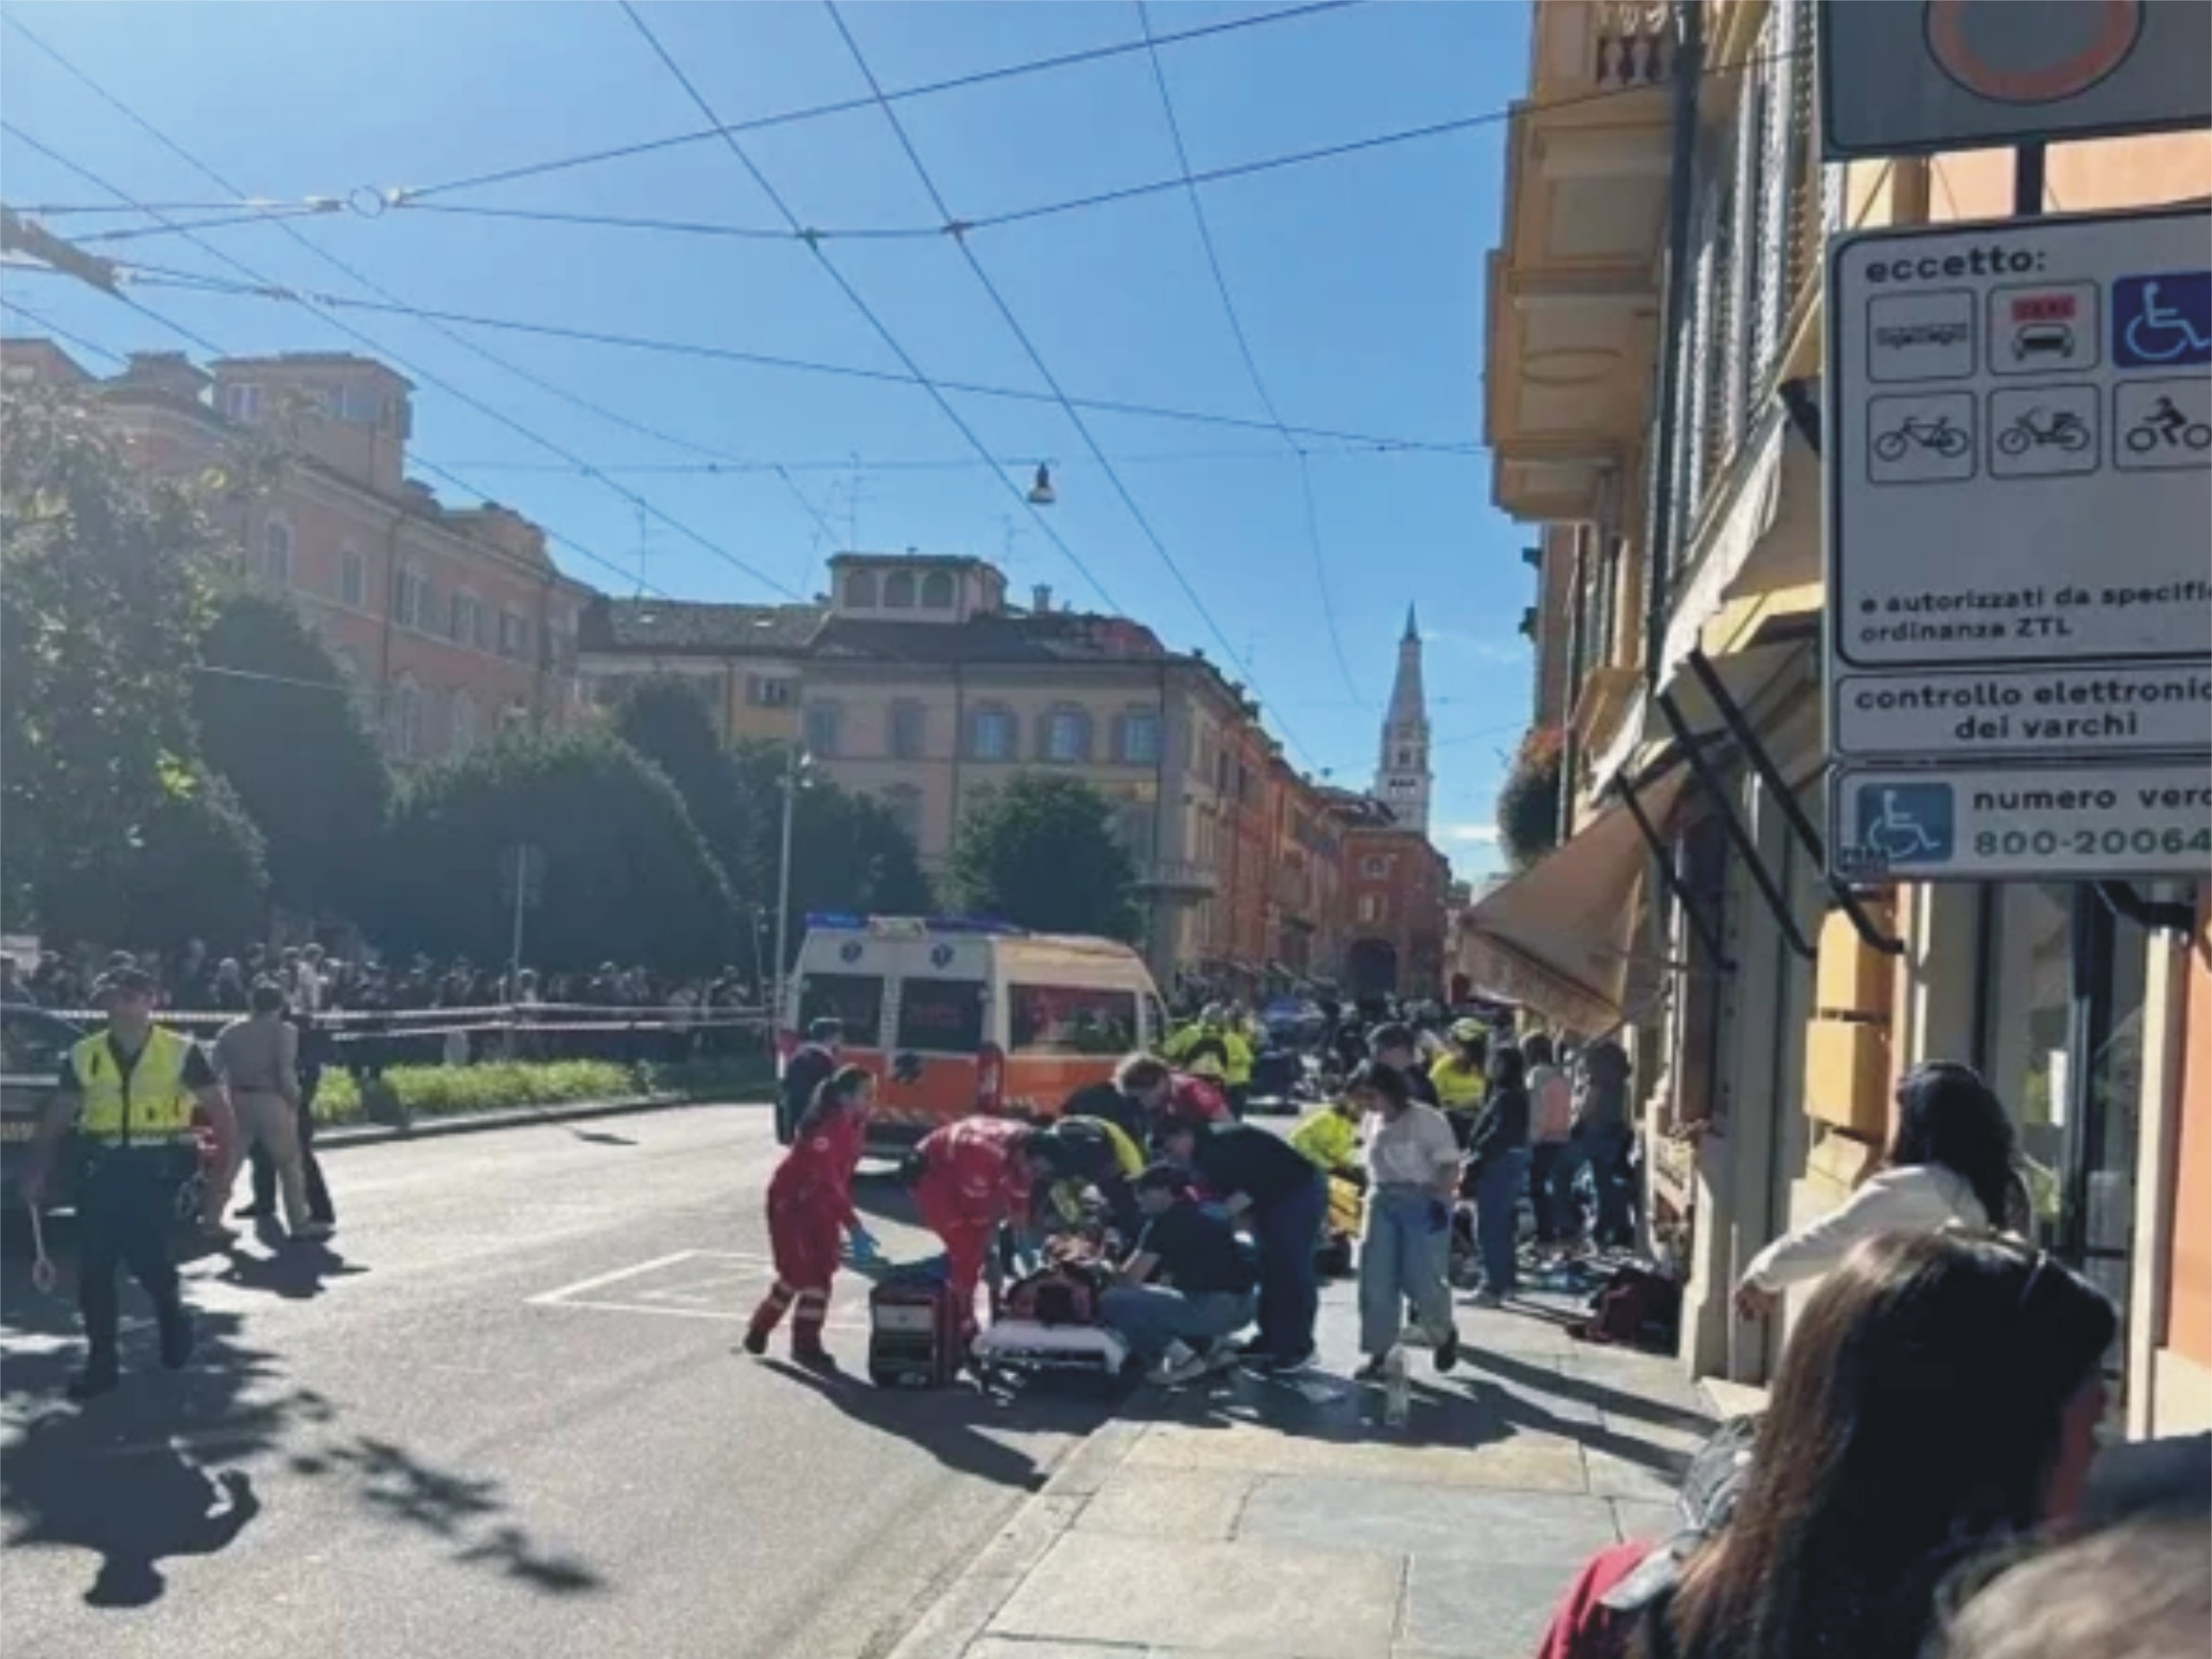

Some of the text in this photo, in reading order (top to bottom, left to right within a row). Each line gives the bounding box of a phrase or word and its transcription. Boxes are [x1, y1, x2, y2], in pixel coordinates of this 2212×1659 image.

[1865, 246, 2046, 282] eccetto:
[1861, 581, 2211, 615] e autorizzati da specifi
[1860, 617, 2072, 644] ordinanza ZTL
[1855, 681, 2023, 710] controllo
[1955, 711, 2137, 740] dei varchi
[1974, 790, 2117, 811] numero
[1974, 827, 2211, 857] 800-20064
